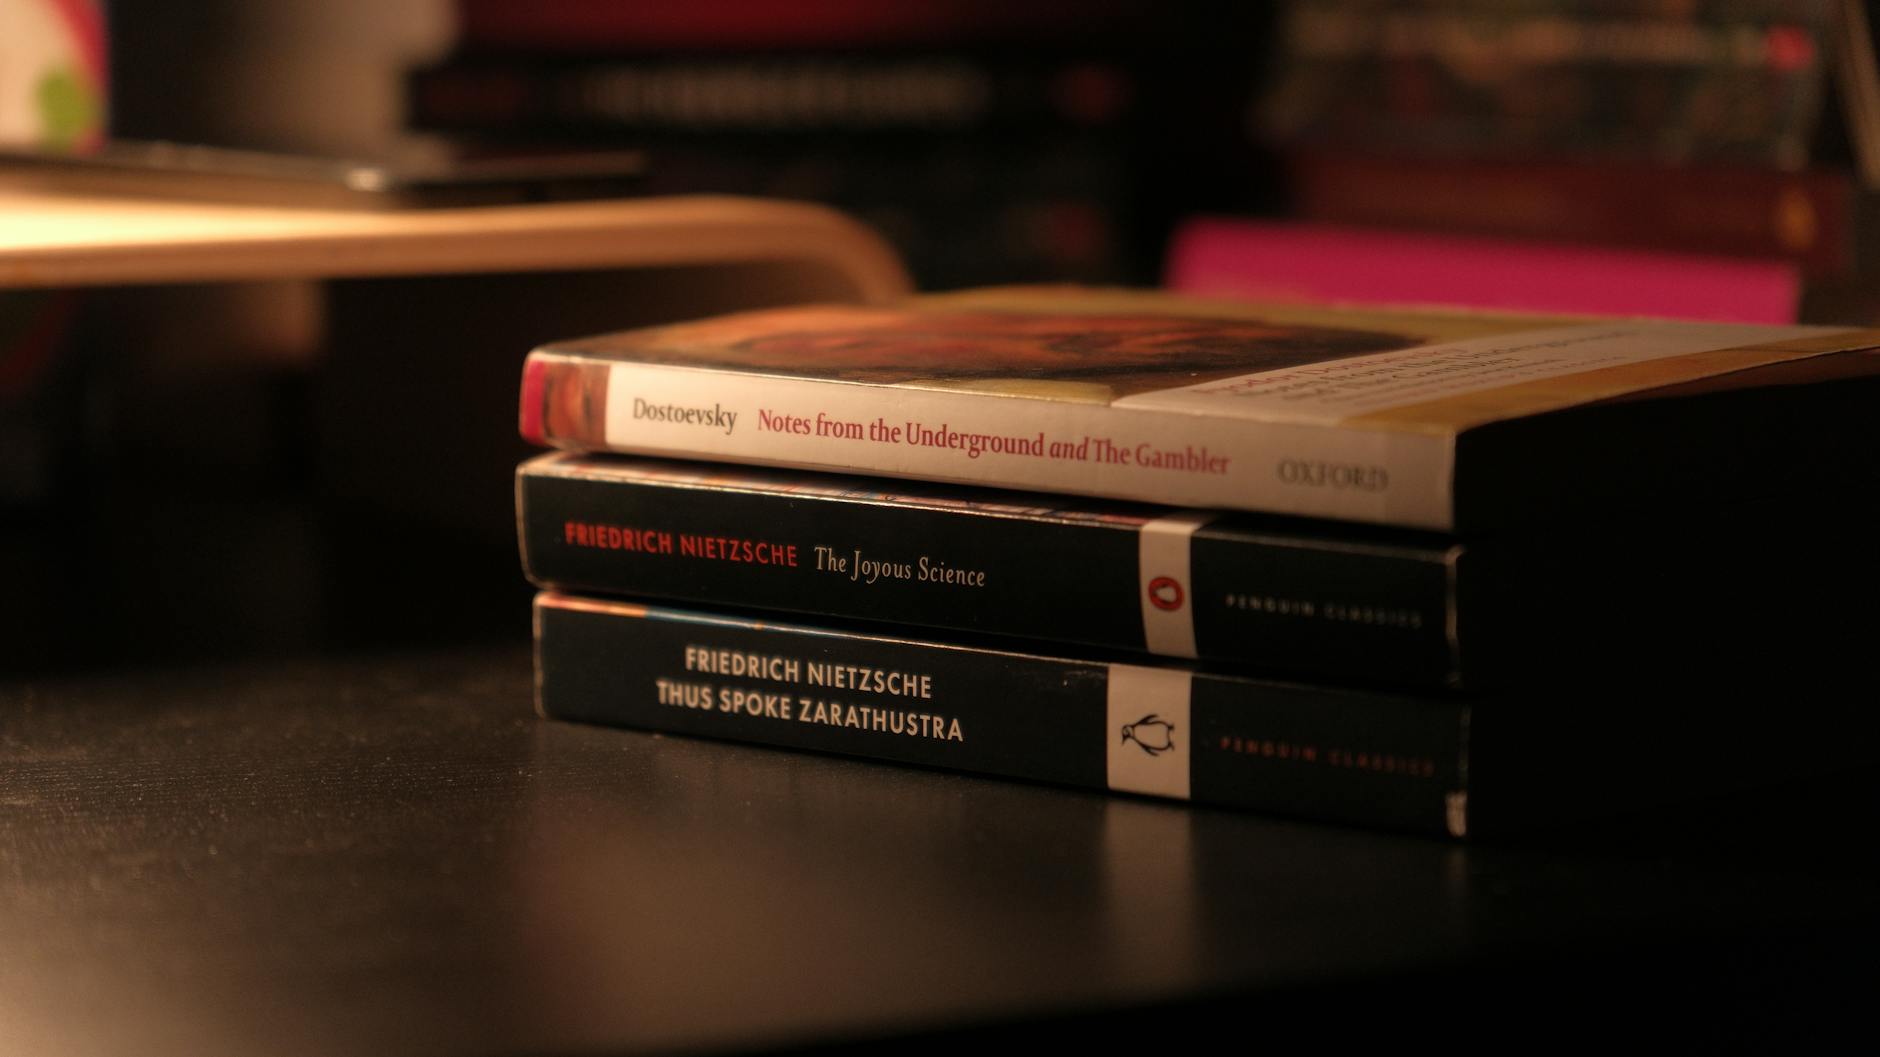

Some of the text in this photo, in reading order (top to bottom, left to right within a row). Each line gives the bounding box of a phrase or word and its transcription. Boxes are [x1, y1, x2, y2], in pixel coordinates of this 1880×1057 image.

[633, 398, 738, 437] Dostoevsky
[759, 409, 1231, 476] Notes from the Underground and The Gambler
[1278, 462, 1390, 494] OXFORD
[564, 521, 798, 567] FRIEDRICH NIETZSCHE
[814, 546, 985, 587] The Joyous Science
[685, 646, 931, 699] FRIEDRICH NIETZSCHE
[656, 680, 964, 742] THUS SPOKE ZARATHUSTRA
